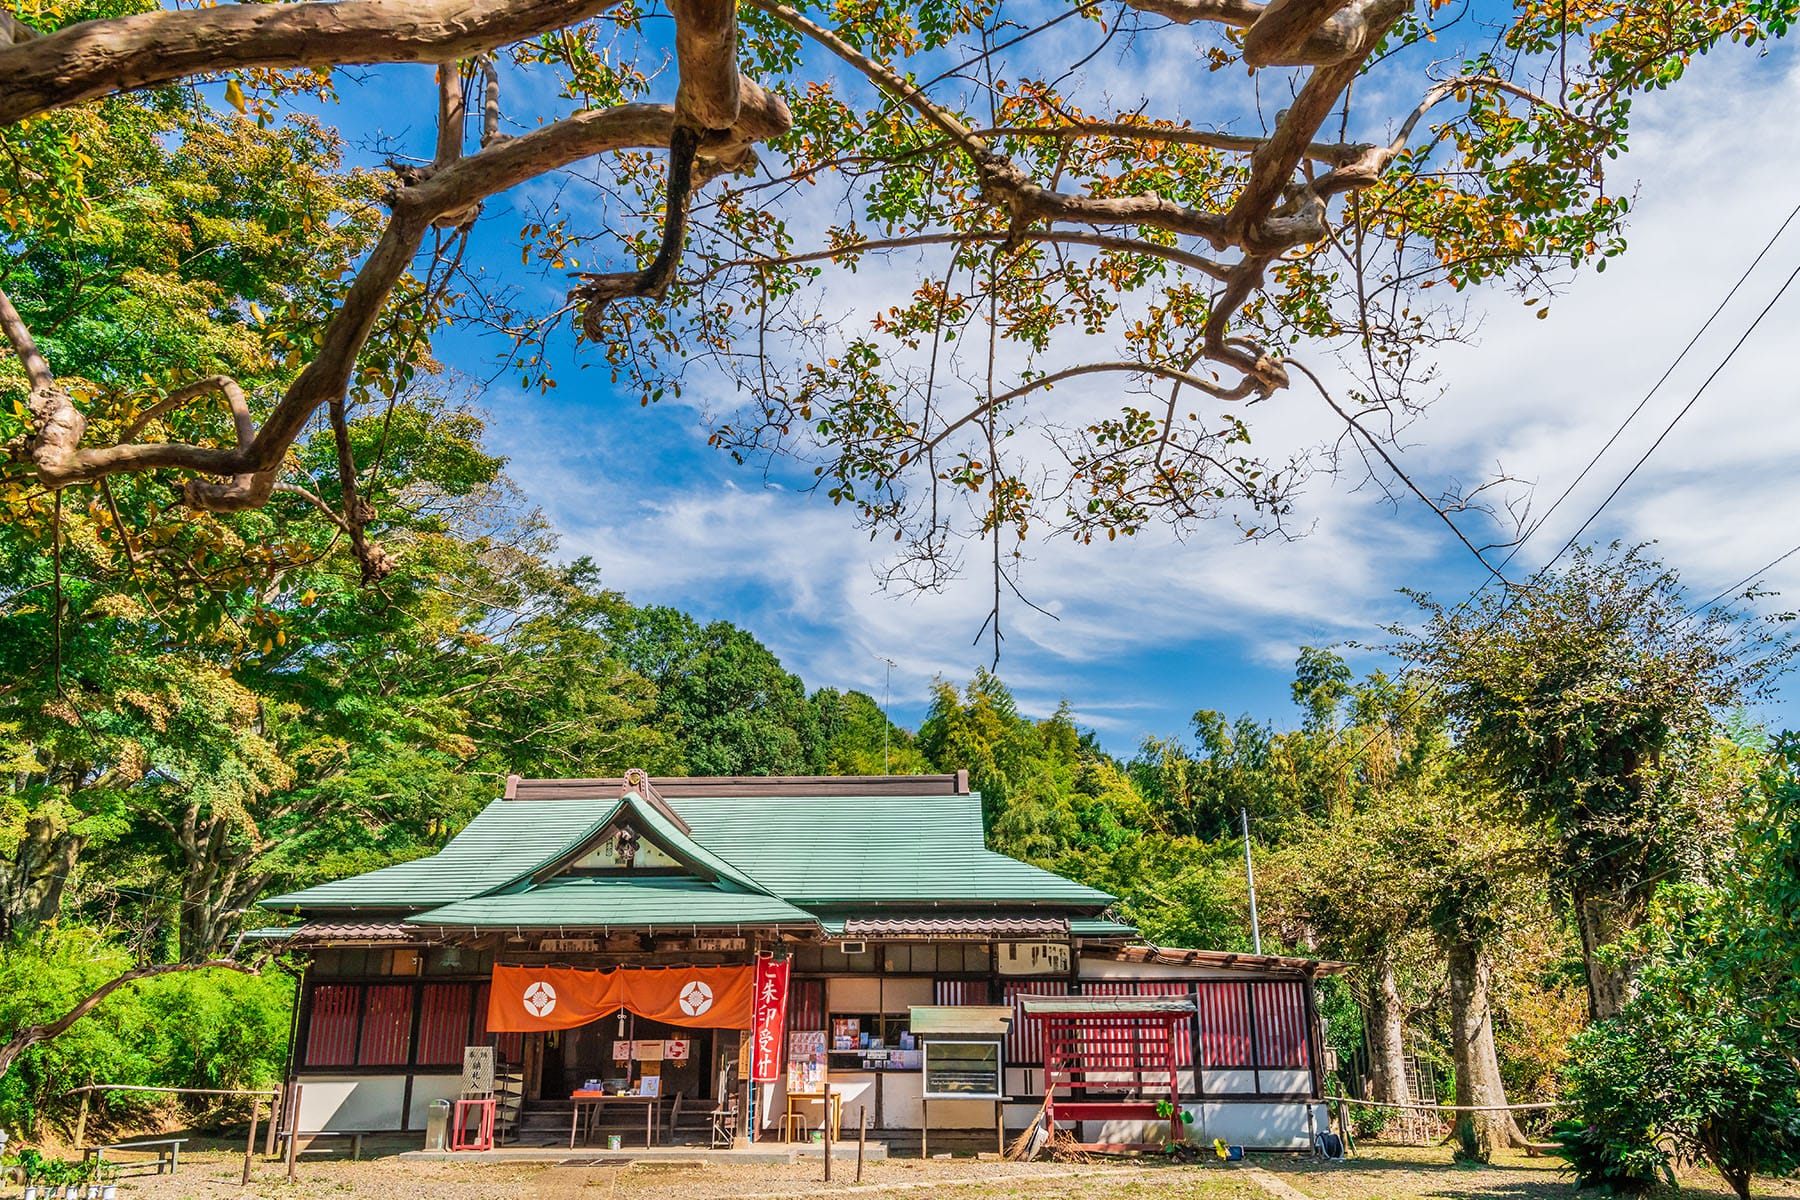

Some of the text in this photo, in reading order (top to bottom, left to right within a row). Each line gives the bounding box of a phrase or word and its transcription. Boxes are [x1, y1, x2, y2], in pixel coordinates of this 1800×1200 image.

[757, 962, 779, 1078] ご朱印受付
